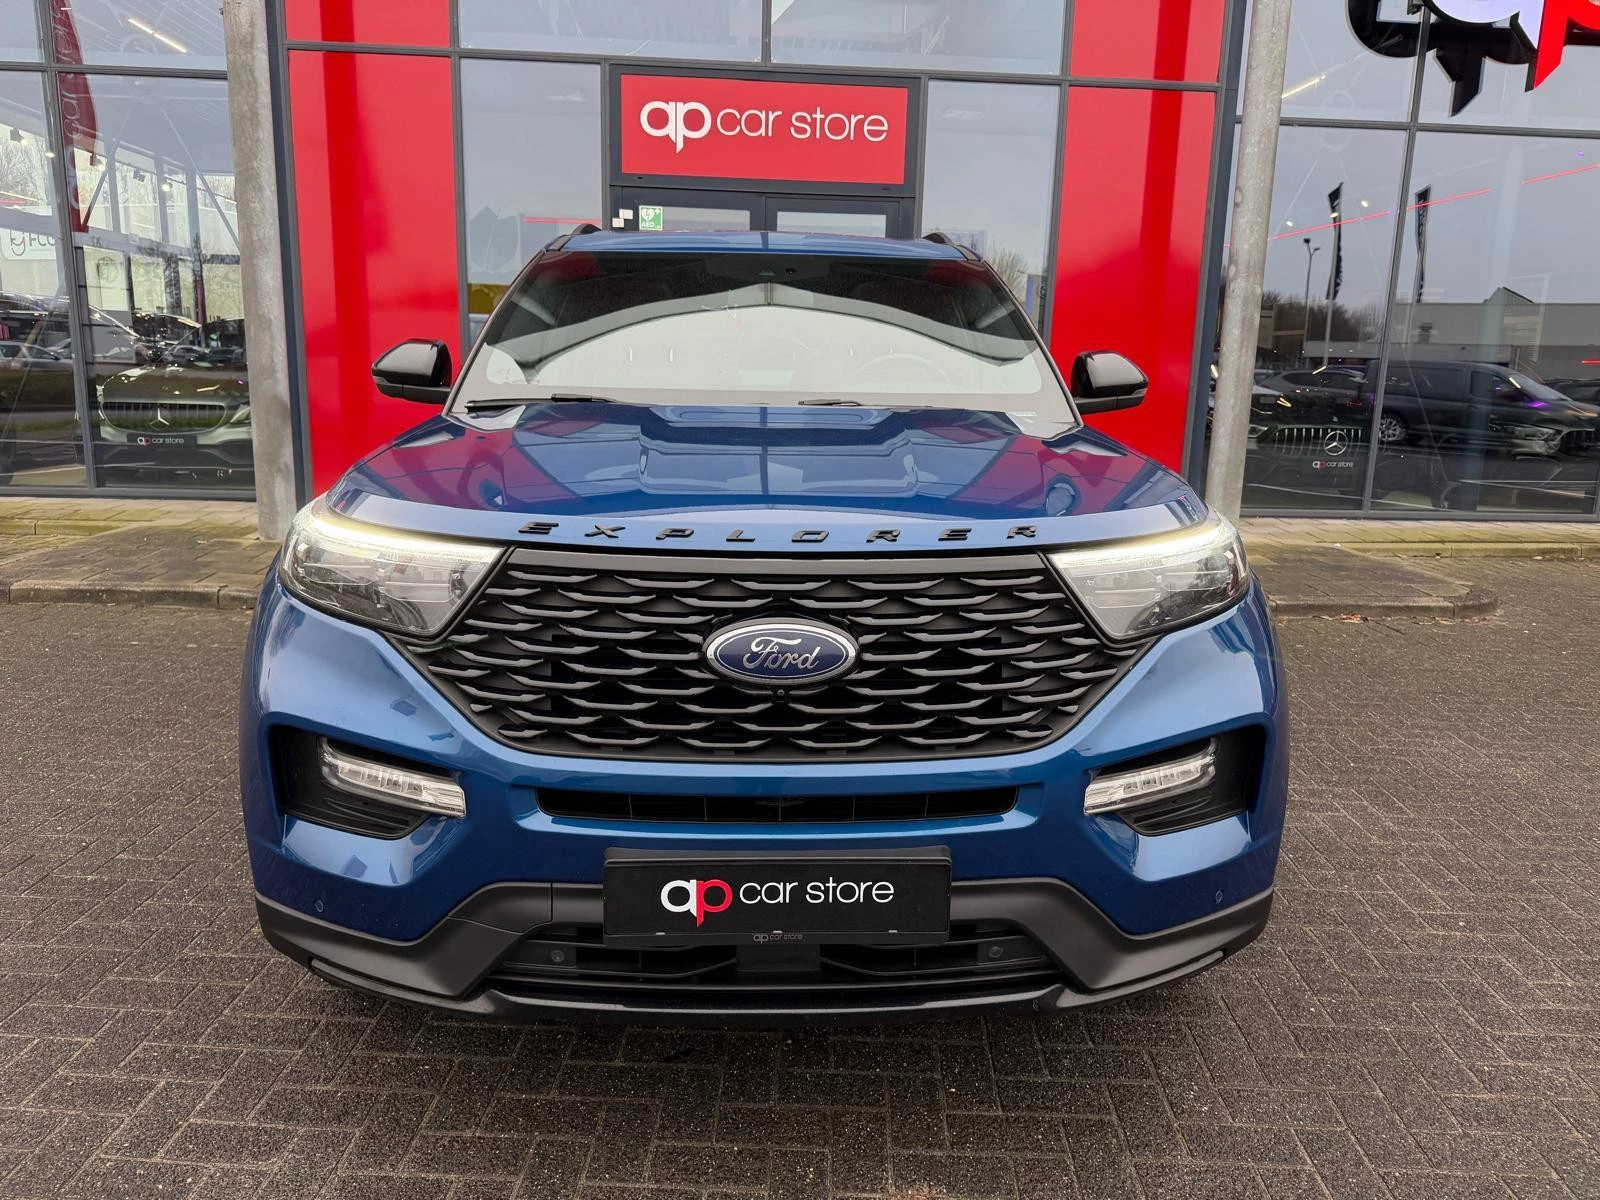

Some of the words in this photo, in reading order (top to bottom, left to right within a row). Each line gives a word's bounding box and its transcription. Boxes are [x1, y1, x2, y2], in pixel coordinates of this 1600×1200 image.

[640, 100, 712, 154] ap
[716, 108, 782, 137] car
[790, 106, 889, 142] store
[518, 521, 1038, 543] EXPLORER
[742, 636, 821, 670] Ford
[660, 879, 733, 927] ap
[739, 881, 798, 904] car
[806, 876, 894, 904] store
